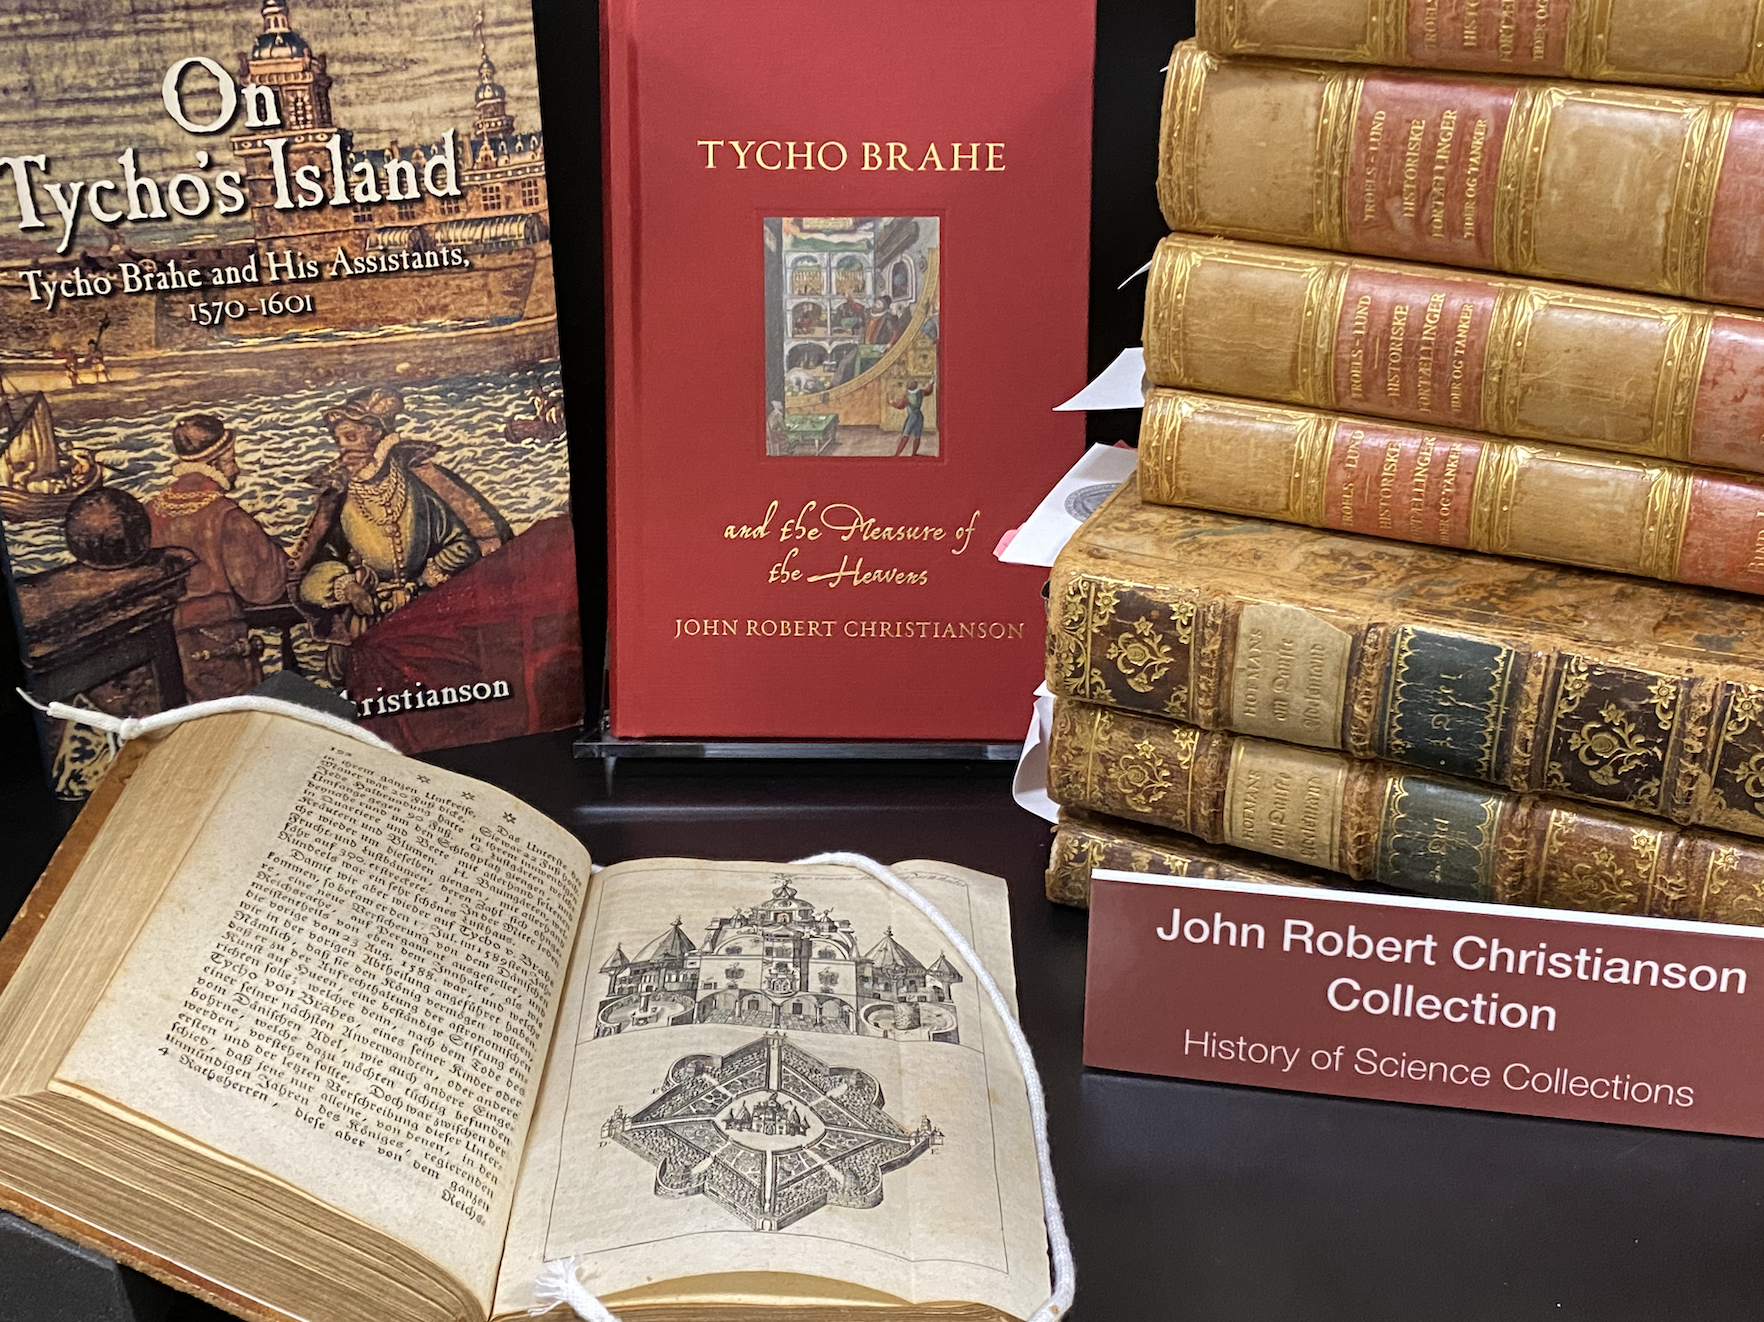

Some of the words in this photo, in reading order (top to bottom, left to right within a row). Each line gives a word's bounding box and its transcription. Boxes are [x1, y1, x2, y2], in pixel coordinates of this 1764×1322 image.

[162, 56, 281, 132] On
[698, 139, 848, 171] TYCHO
[861, 142, 1006, 172] BRAHE
[1402, 118, 1426, 218] HISTORISKE
[1468, 119, 1488, 175] TANKER
[0, 148, 247, 254] Tycho's
[265, 128, 461, 210] Island
[1465, 177, 1477, 198] OG
[19, 268, 112, 311] Tycho
[118, 261, 201, 294] Brahe
[212, 255, 259, 287] and
[268, 251, 319, 282] His
[329, 245, 471, 278] Assistants,
[1387, 304, 1409, 398] HISTORISKE
[1455, 303, 1473, 357] TANKER
[1452, 360, 1464, 380] OG
[1379, 441, 1402, 529] HISTORISKE
[1443, 442, 1463, 495] TANKER
[723, 500, 778, 541] and
[780, 500, 821, 541] the
[821, 503, 946, 542] Measure
[952, 509, 981, 556] of
[1440, 497, 1452, 517] OG
[768, 547, 804, 584] the
[807, 555, 928, 590] Heavens
[674, 619, 739, 639] JOHN
[745, 619, 836, 640] ROBERT
[843, 621, 1025, 641] CHRISTIANSON
[357, 679, 510, 718] ristianson
[1243, 629, 1263, 717] HOFMANS
[1241, 769, 1261, 841] HOFMANS
[1156, 907, 1267, 951] John
[1282, 917, 1438, 967] Robert
[1452, 935, 1748, 995] Christianson
[1326, 977, 1557, 1032] Collection
[1183, 1029, 1300, 1070] History
[1311, 1045, 1343, 1071] of
[1354, 1047, 1491, 1088] Science
[1502, 1063, 1695, 1107] Collections
